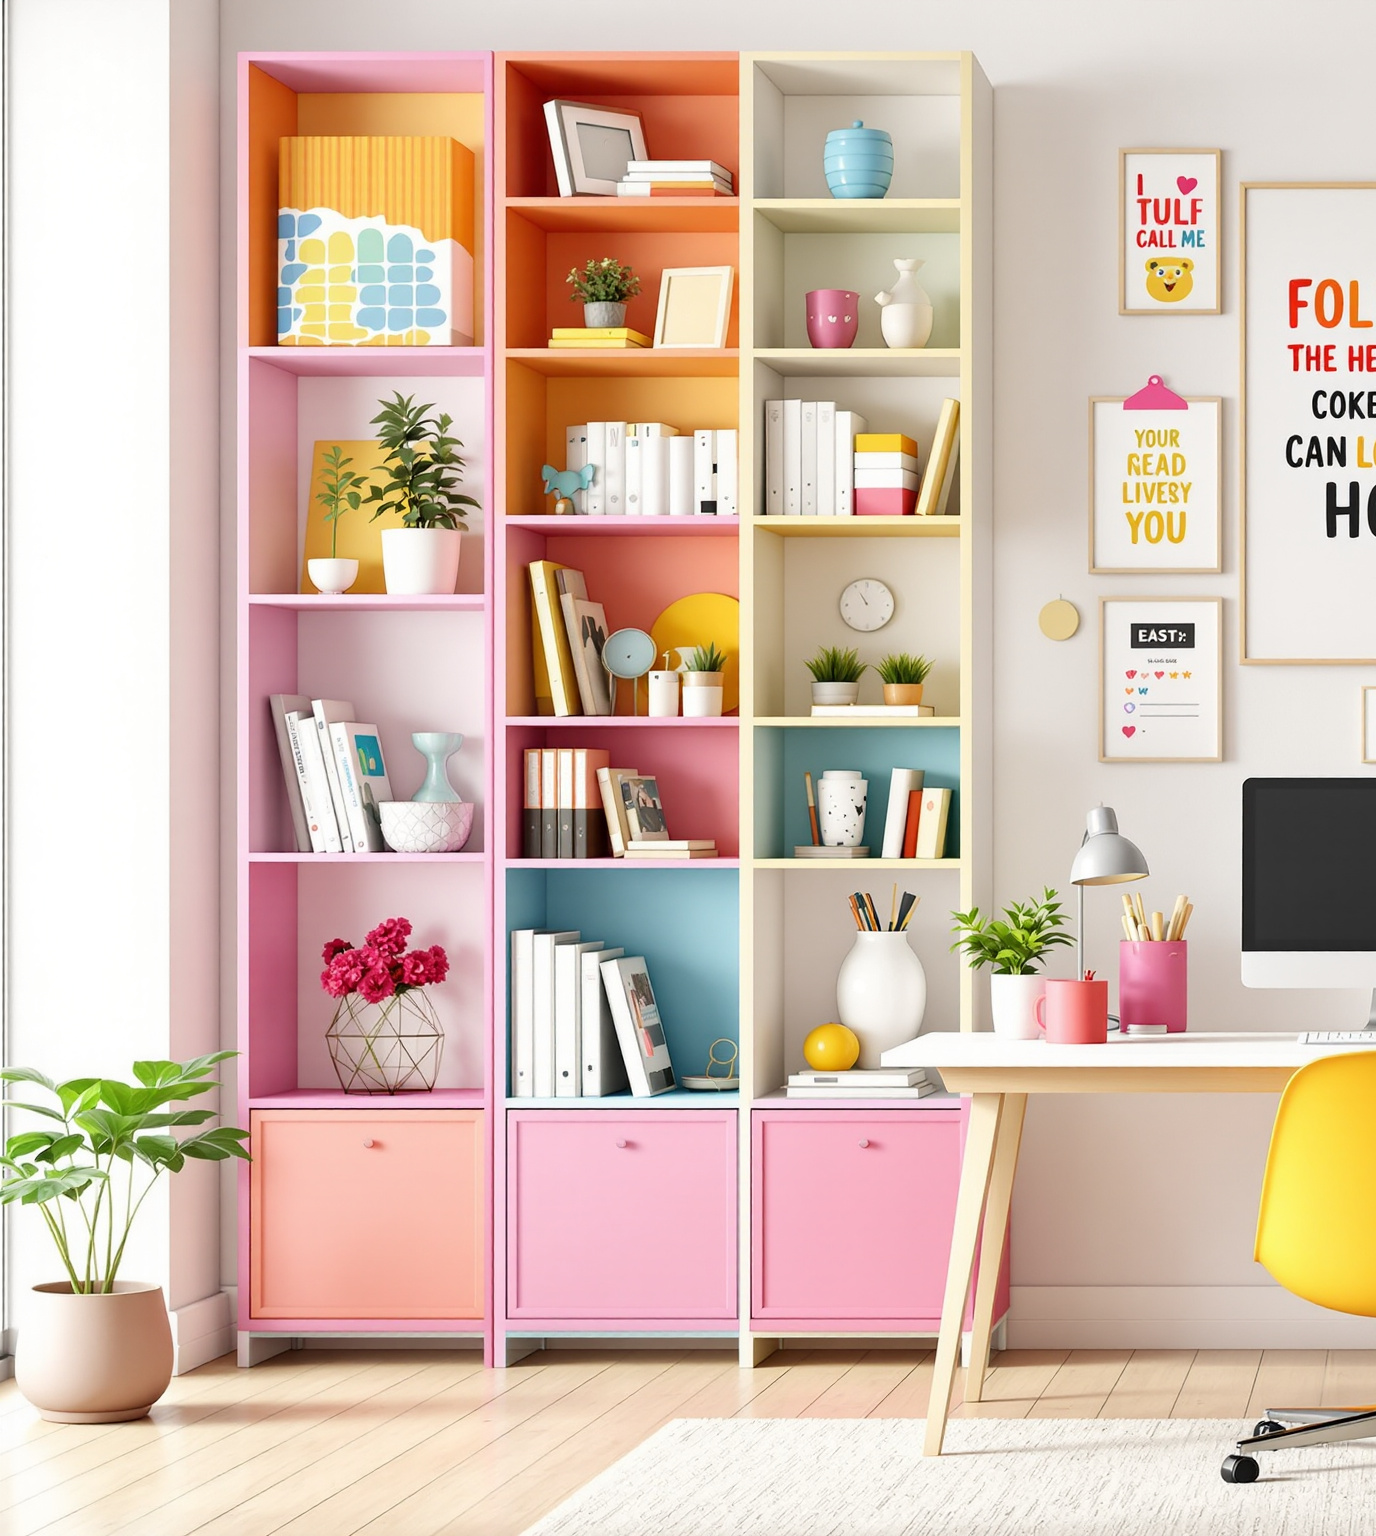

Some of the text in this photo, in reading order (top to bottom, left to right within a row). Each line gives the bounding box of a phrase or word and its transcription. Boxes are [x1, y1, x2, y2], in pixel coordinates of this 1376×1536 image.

[1136, 173, 1144, 196] I
[1136, 197, 1204, 226] TULF
[1135, 229, 1206, 249] CALL ME
[1286, 343, 1338, 373] THE
[1134, 428, 1180, 449] YOUR
[1285, 434, 1347, 469] CAN
[1125, 510, 1187, 545] YOU
